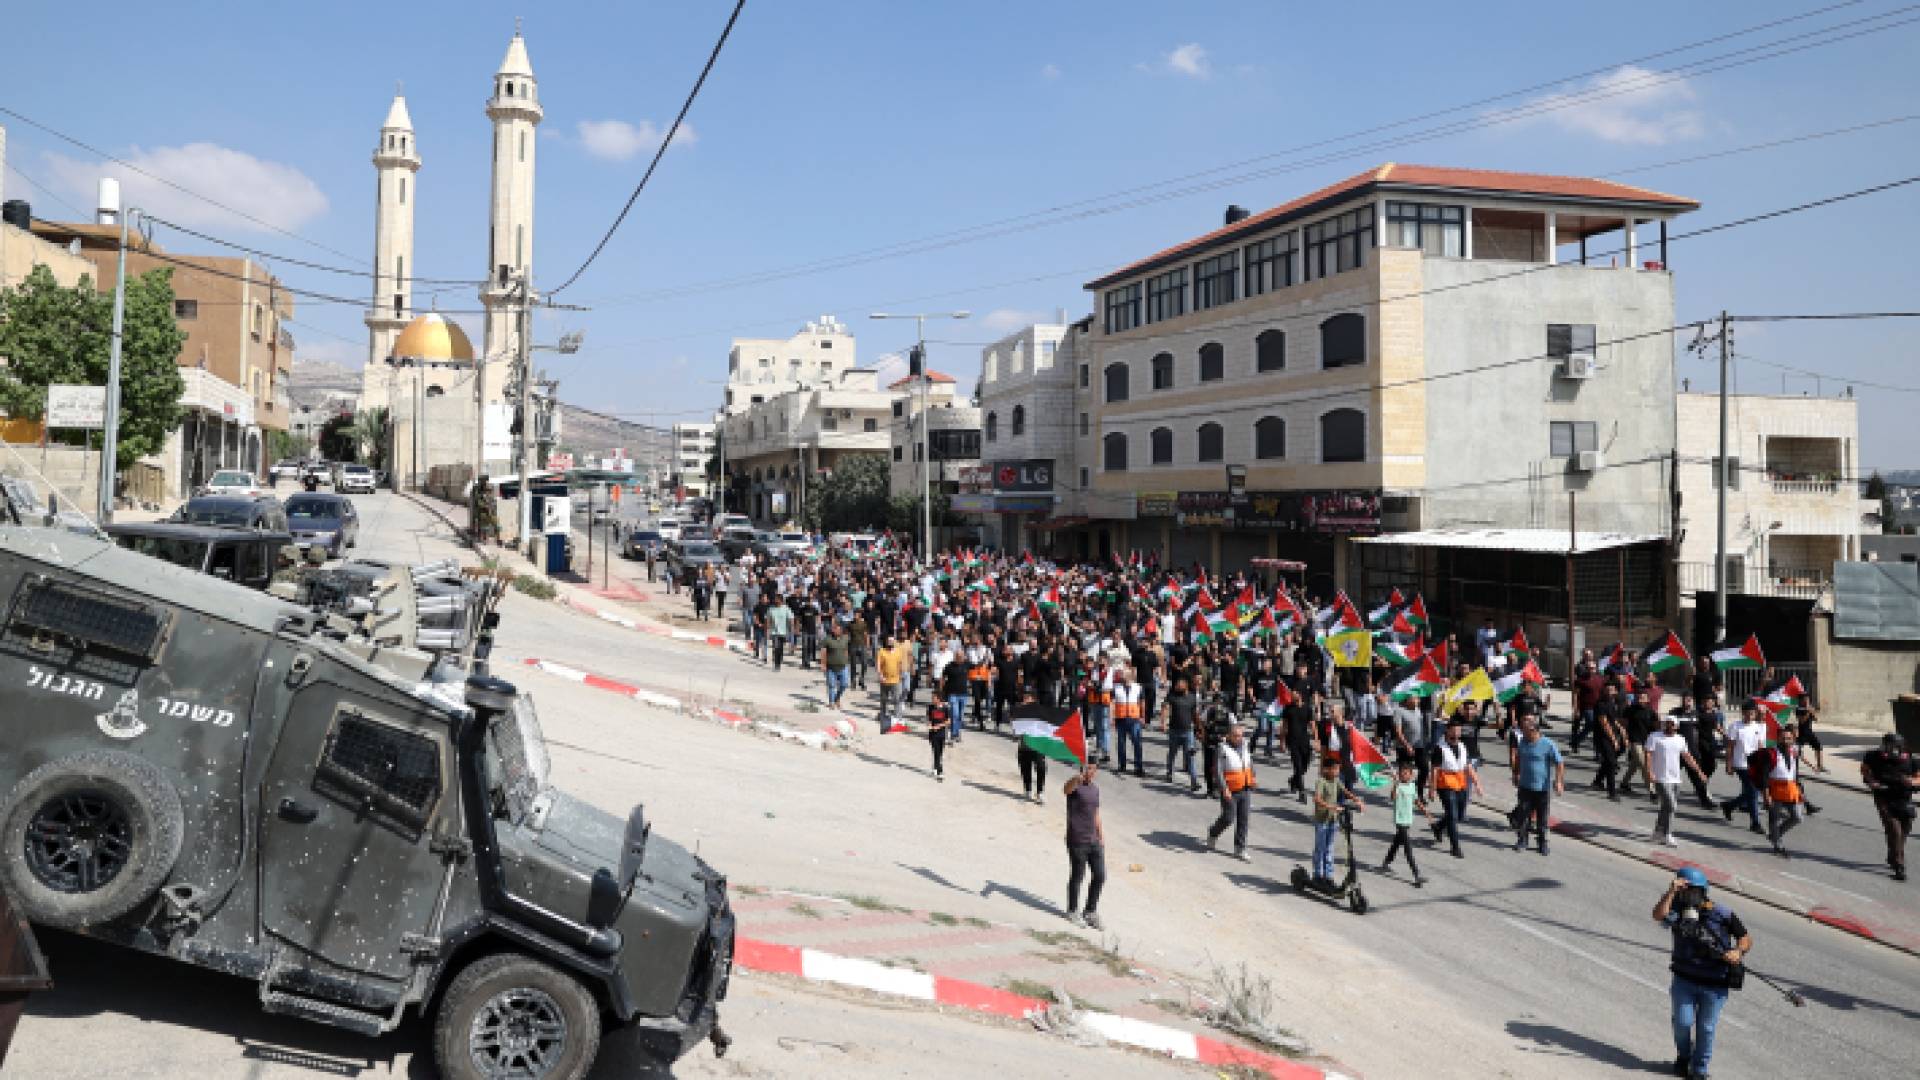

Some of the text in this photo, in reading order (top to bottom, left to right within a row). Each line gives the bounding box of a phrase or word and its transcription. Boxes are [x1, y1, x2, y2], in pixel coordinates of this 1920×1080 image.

[1020, 466, 1049, 484] LG
[26, 666, 235, 727] משמר הגבול
